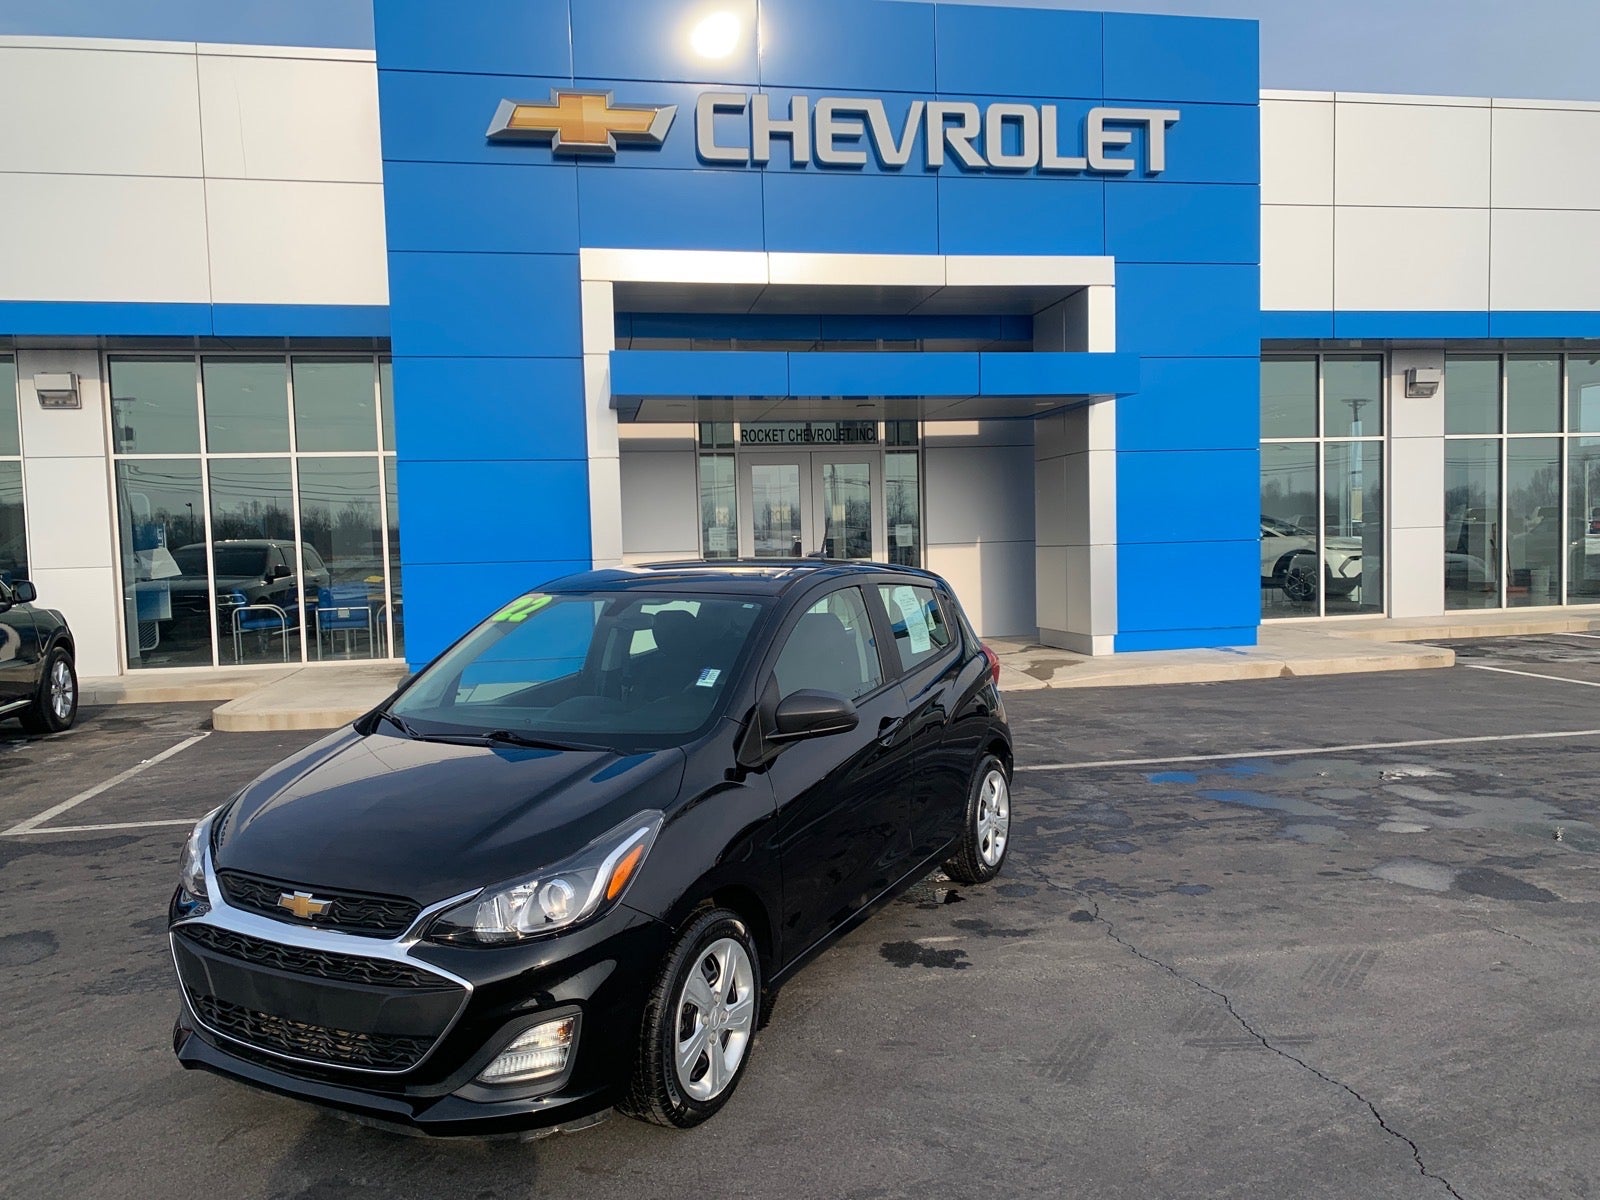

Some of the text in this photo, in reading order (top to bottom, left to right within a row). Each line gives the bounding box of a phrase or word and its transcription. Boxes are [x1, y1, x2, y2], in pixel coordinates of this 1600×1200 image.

[696, 92, 1180, 174] CHEVROLET
[741, 429, 785, 442] ROCKET
[856, 427, 876, 441] INC.
